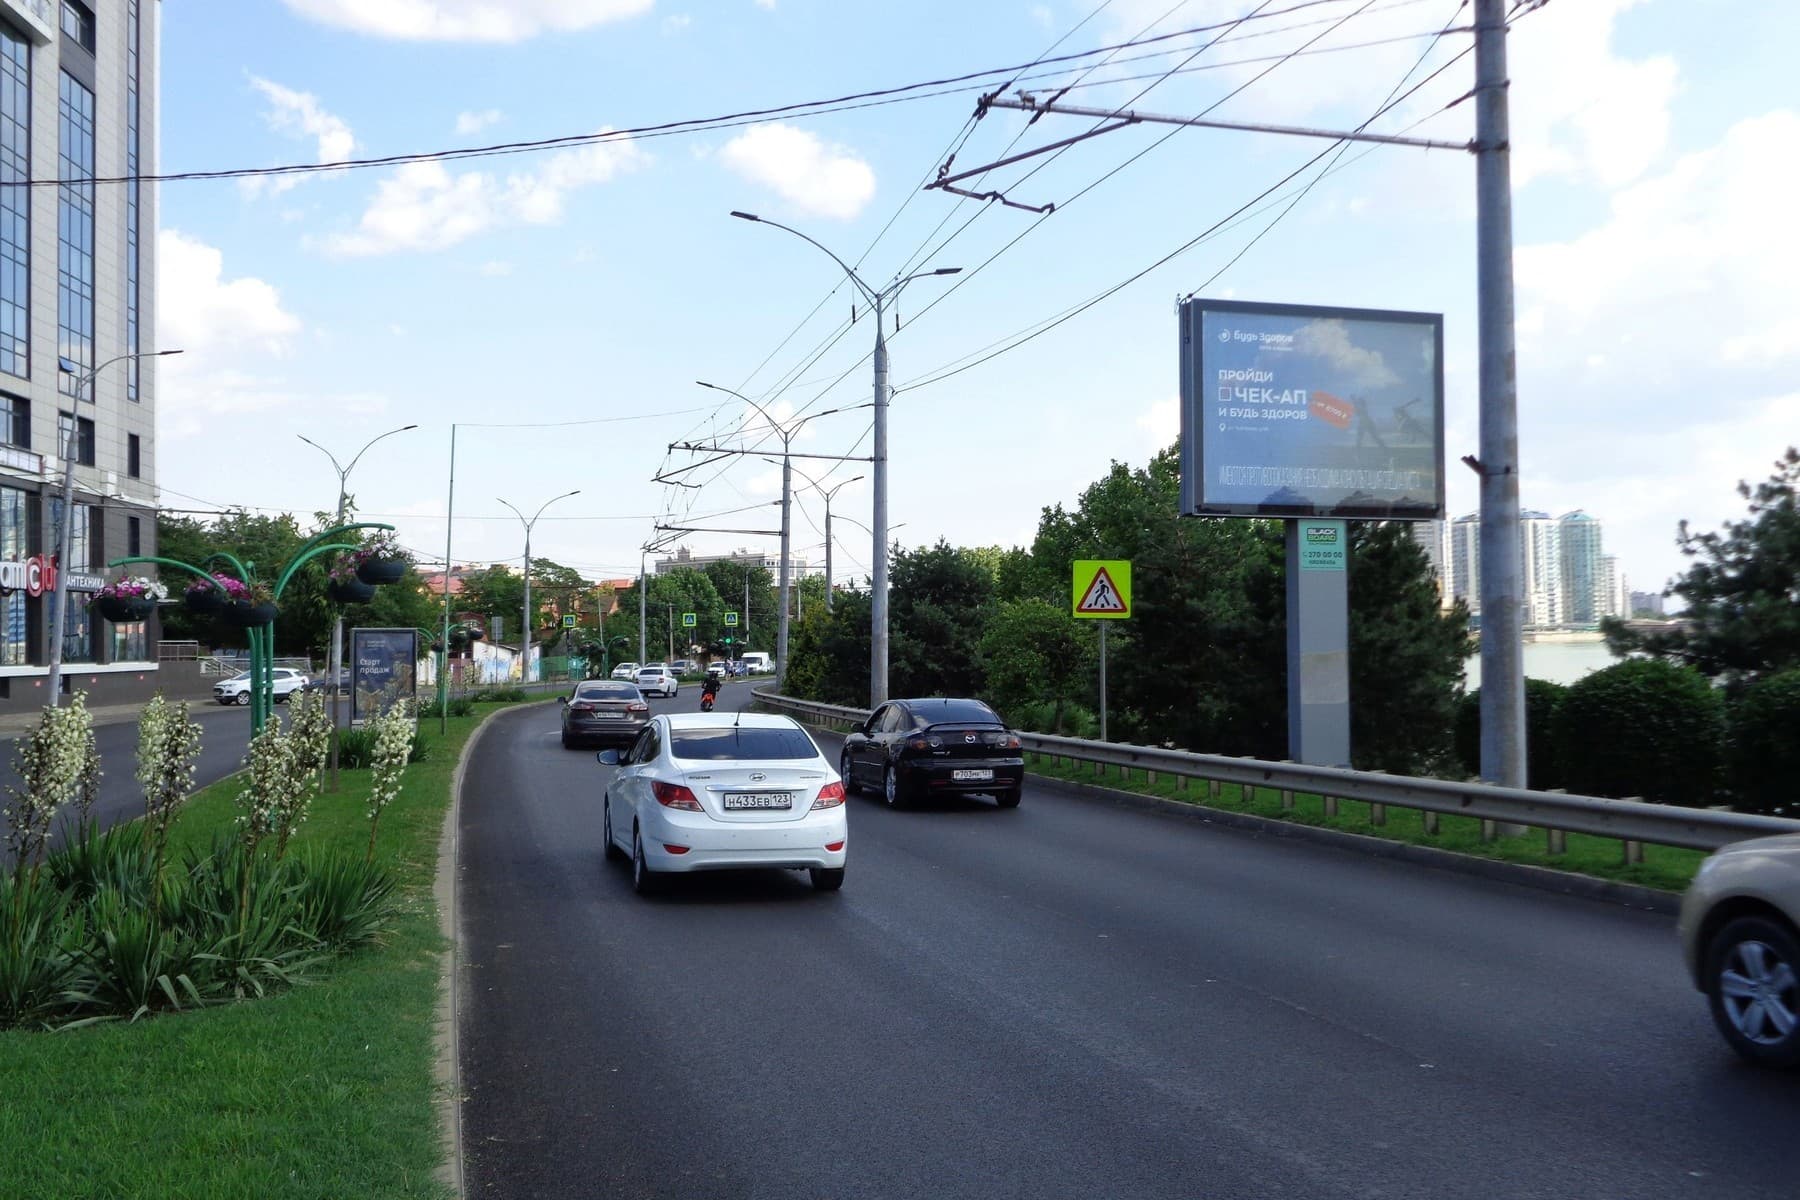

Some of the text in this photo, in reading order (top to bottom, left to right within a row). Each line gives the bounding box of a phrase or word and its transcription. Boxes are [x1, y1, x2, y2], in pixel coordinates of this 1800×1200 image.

[1218, 368, 1273, 382] ПРОЙДИ
[1234, 387, 1307, 405] ЧЕК-АП
[1218, 407, 1227, 417] И
[1230, 408, 1259, 418] БУДЬ
[1261, 409, 1308, 420] ЗДОРОВ
[66, 575, 105, 589] АНТЕХНИКА
[359, 658, 380, 667] Старт
[360, 667, 389, 675] продаж
[772, 794, 789, 803] 123
